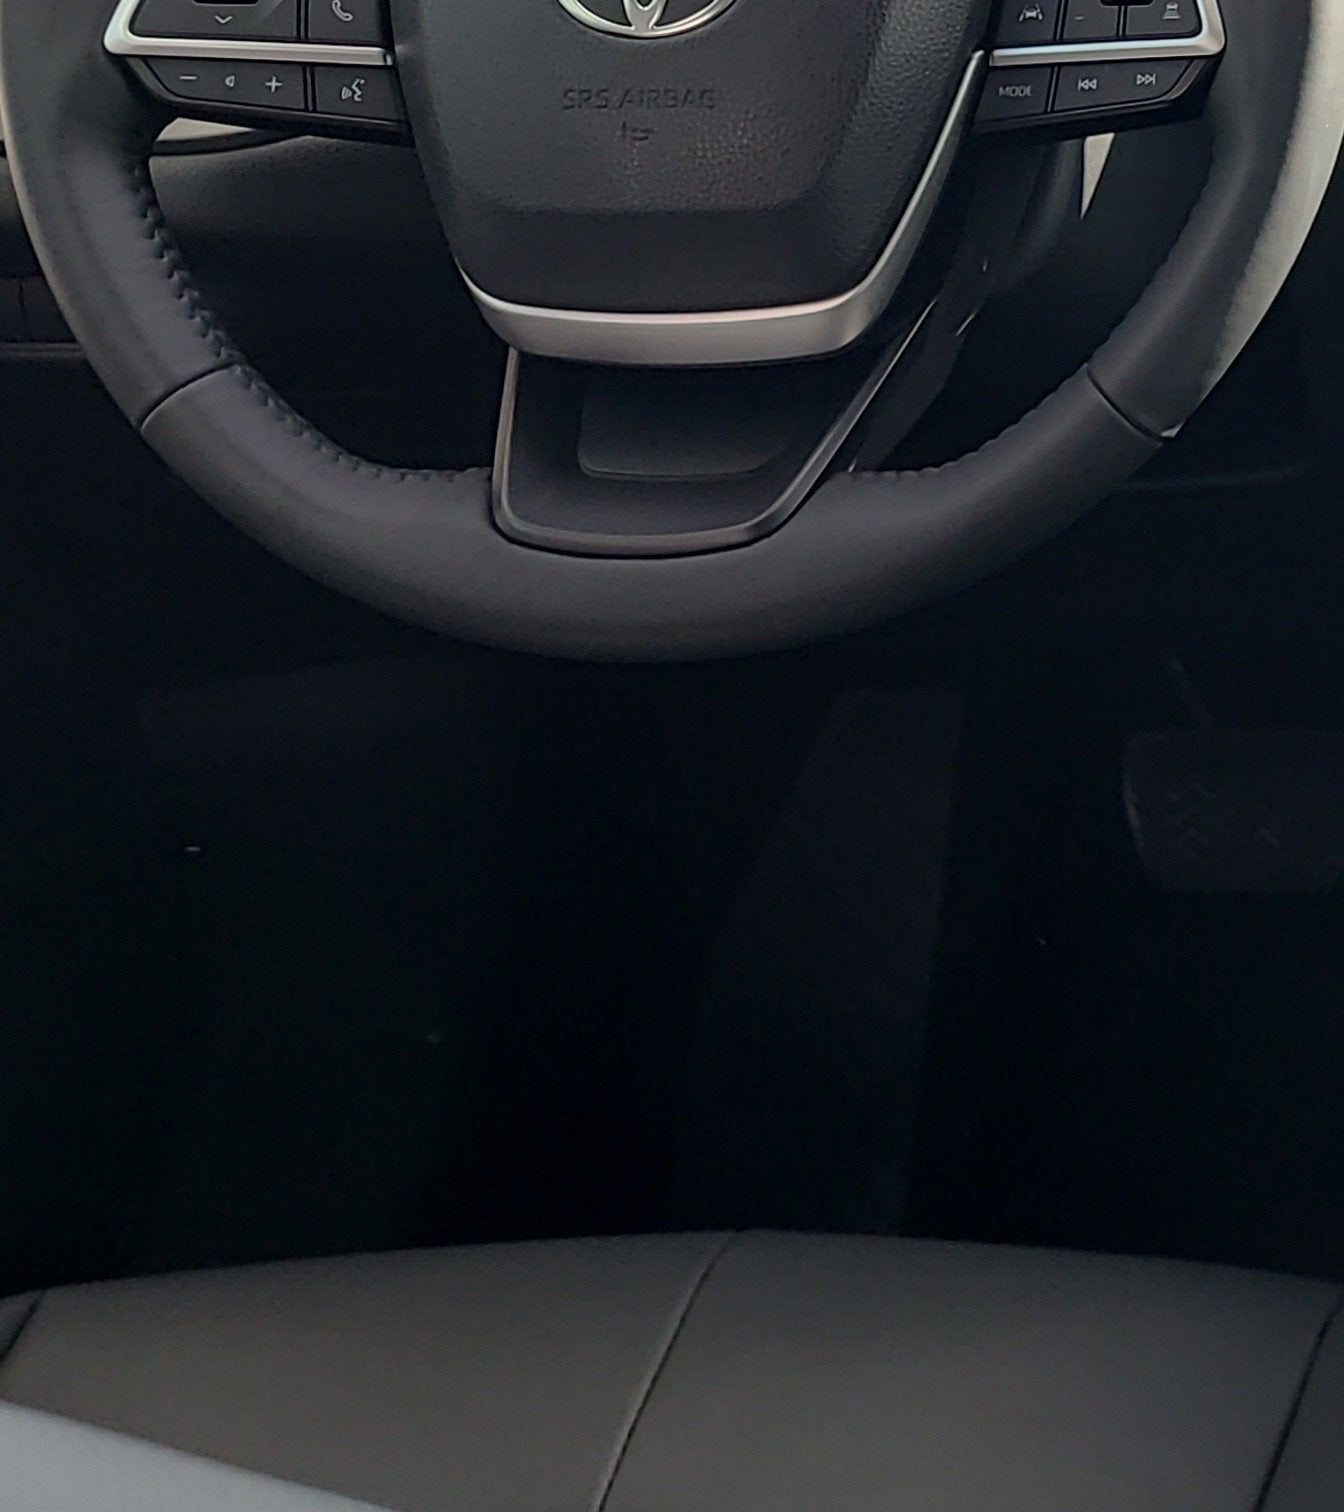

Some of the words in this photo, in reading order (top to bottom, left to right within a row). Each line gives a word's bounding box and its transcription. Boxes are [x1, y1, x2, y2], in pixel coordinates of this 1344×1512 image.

[562, 88, 610, 110] SRS
[618, 88, 716, 110] AIRBAG
[998, 85, 1032, 97] MODE
